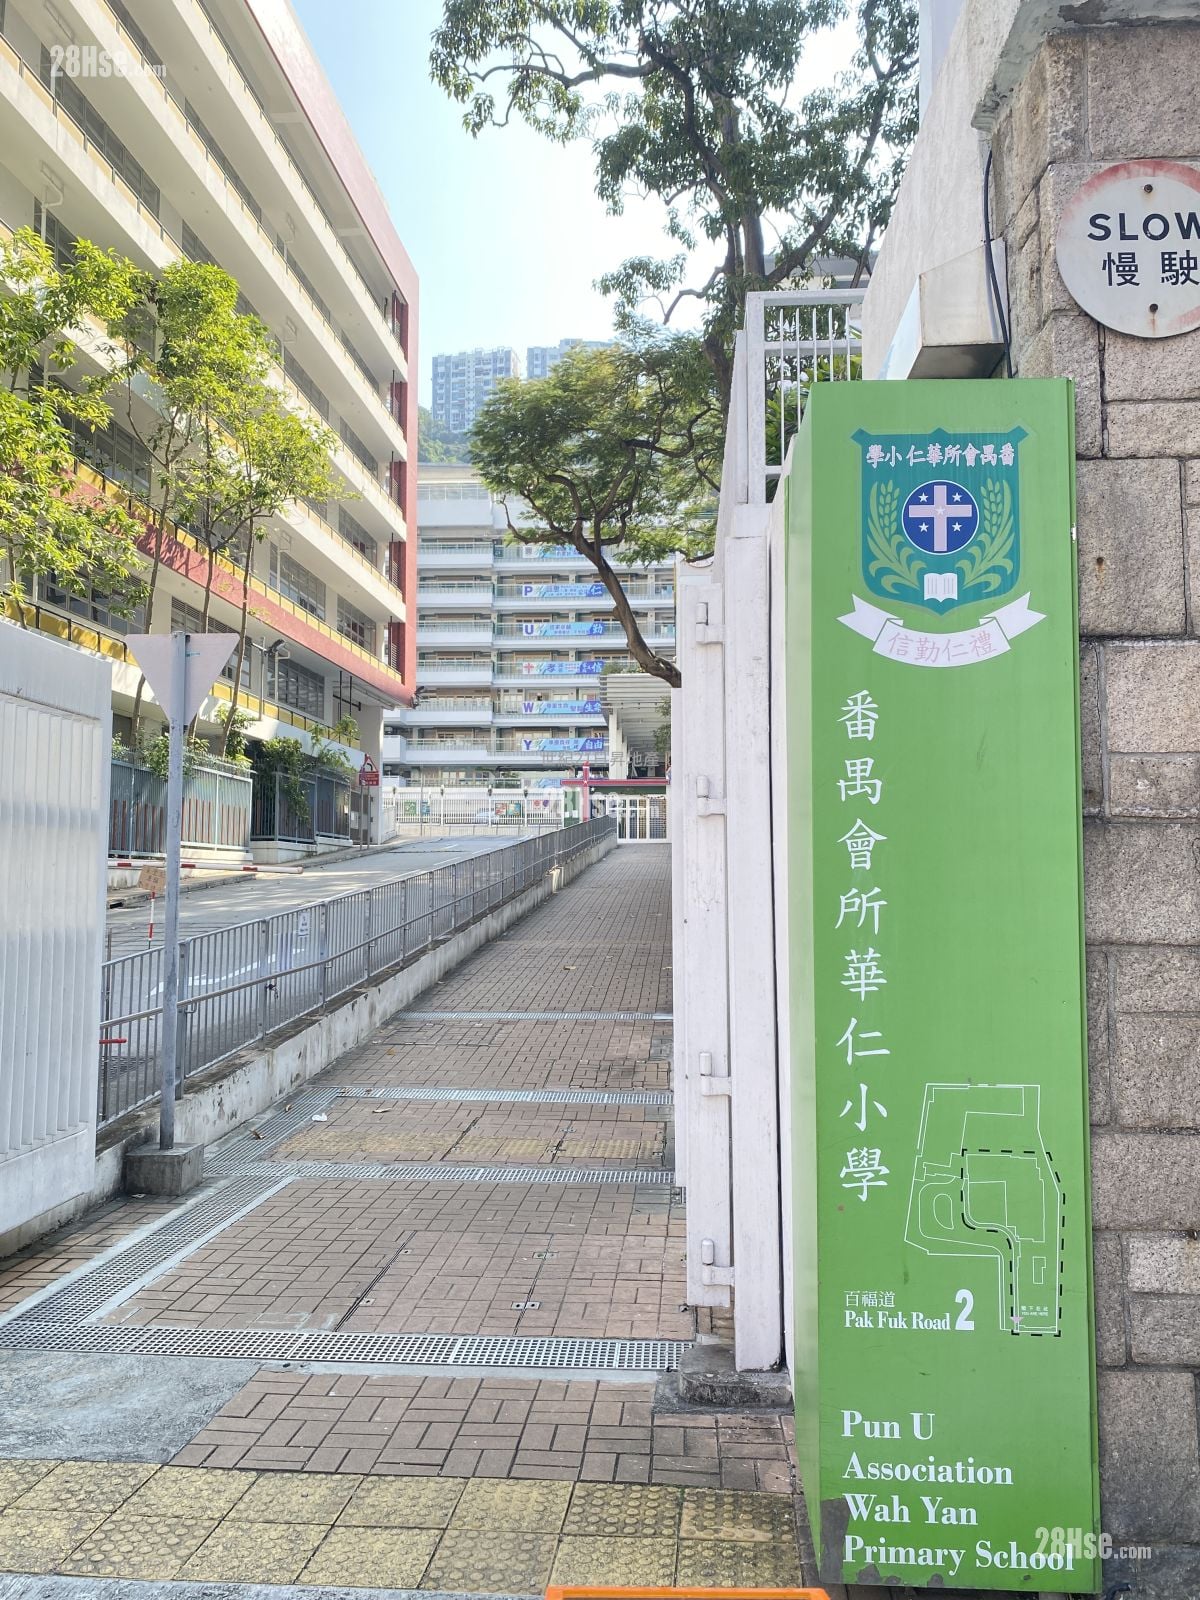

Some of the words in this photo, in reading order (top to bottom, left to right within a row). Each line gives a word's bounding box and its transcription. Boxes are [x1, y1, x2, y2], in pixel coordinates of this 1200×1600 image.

[1088, 212, 1200, 241] SLOW
[1102, 250, 1199, 287] 慢駛
[524, 586, 533, 596] P
[525, 625, 534, 635] U
[523, 702, 534, 713] W
[523, 740, 532, 750] Y
[836, 690, 890, 1202] 番禺會所華仁小學
[844, 1290, 896, 1308] 百福道
[845, 1310, 872, 1328] Pak
[876, 1311, 908, 1329] Fuk
[911, 1312, 950, 1331] Road
[954, 1288, 975, 1331] 2
[841, 1410, 901, 1439] Pun
[910, 1412, 935, 1440] U
[842, 1452, 1014, 1485] Association
[843, 1494, 910, 1523] Wah
[919, 1496, 978, 1526] Yan
[843, 1535, 966, 1576] Primary
[976, 1541, 1074, 1571] School
